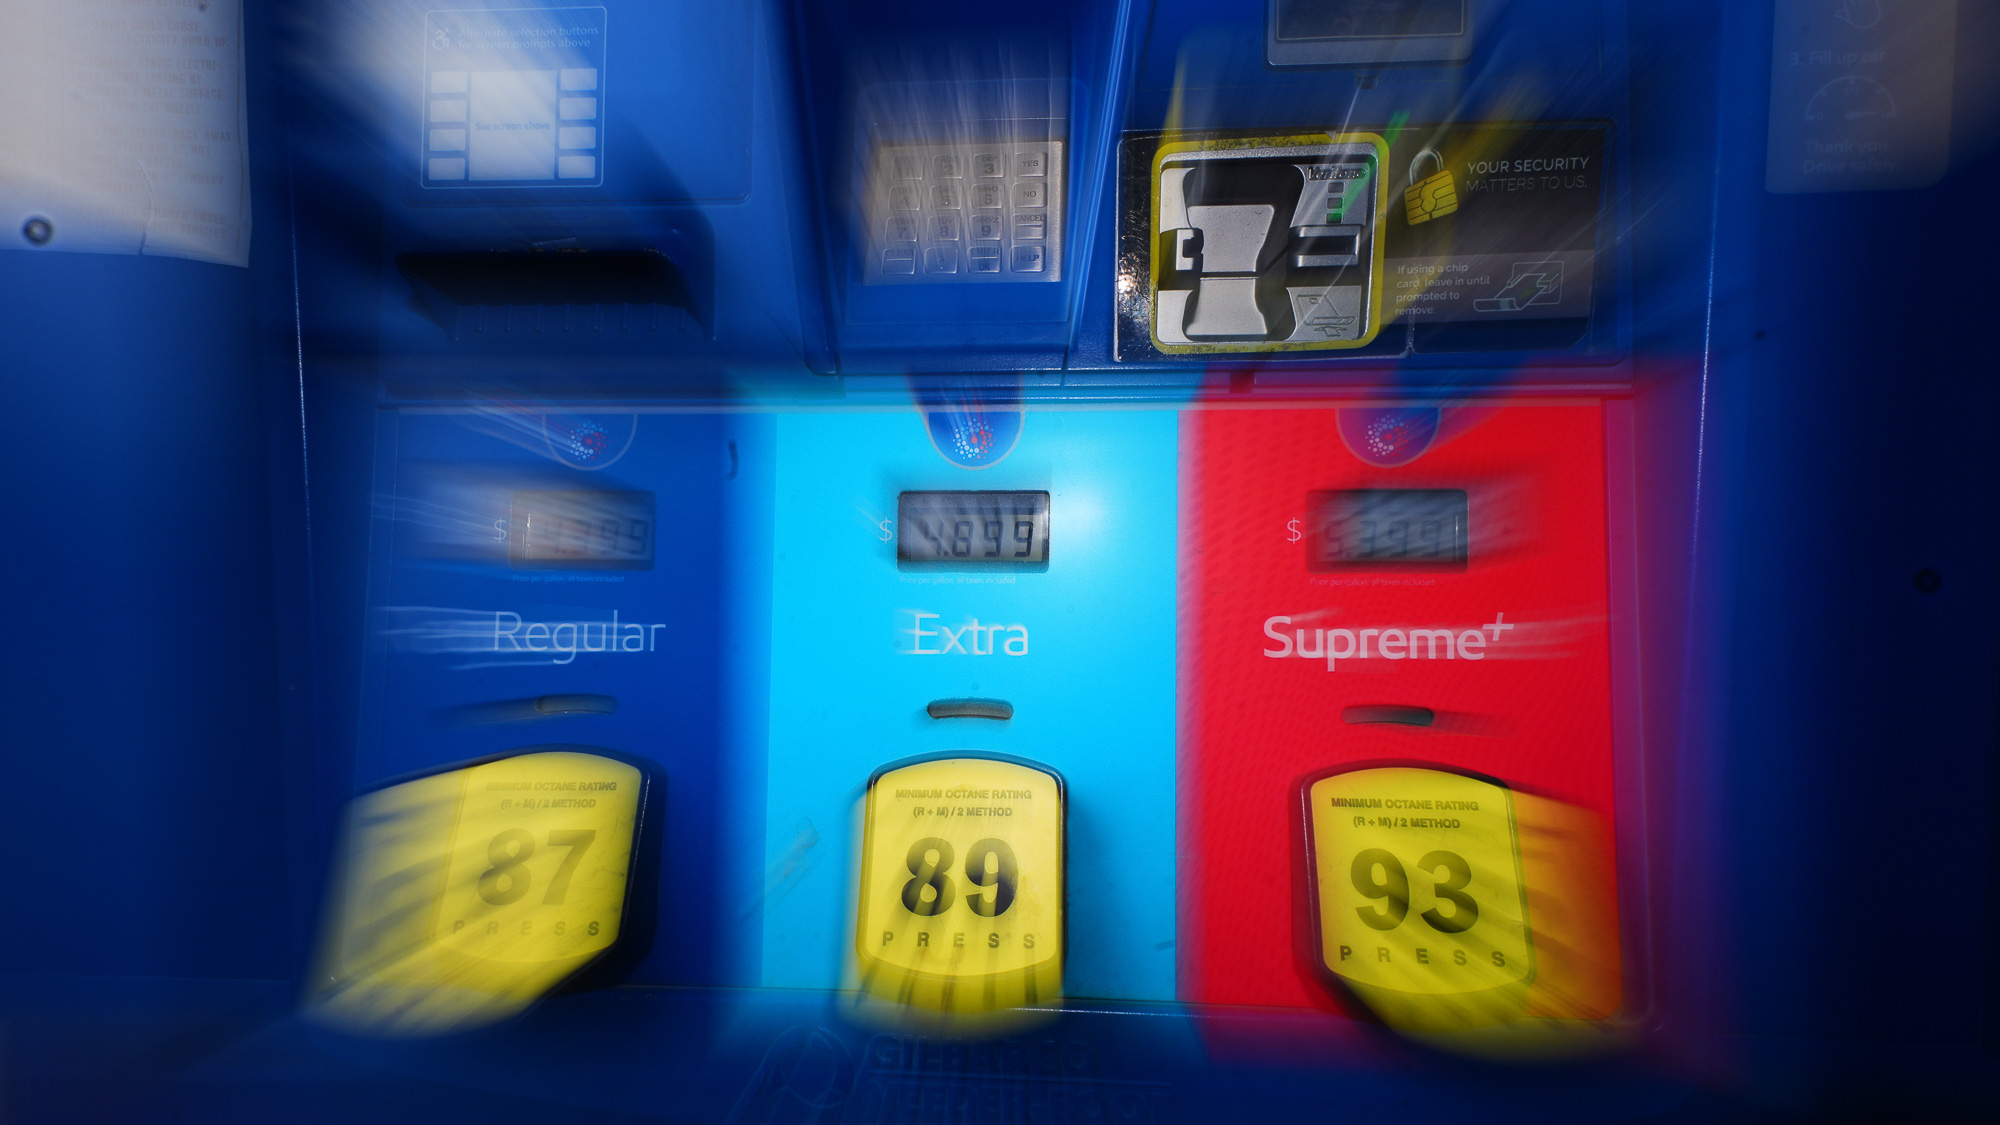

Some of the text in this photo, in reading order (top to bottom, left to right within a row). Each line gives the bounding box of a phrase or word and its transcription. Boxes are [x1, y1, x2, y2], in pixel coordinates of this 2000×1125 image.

[509, 27, 557, 37] selection
[559, 26, 599, 36] buttons
[475, 40, 510, 49] screen
[512, 39, 556, 50] prompts
[558, 38, 590, 48] above
[1789, 51, 1886, 66] 3. Fill up car
[475, 121, 550, 131] See screen above
[1804, 140, 1893, 155] Thank you.
[943, 164, 954, 176] 2
[984, 163, 995, 175] 3
[1022, 160, 1039, 168] YES
[1467, 157, 1589, 175] YOUR SECURITY
[1803, 159, 1901, 175] Drive safely.
[1465, 175, 1588, 193] MATTERS TO US.
[984, 194, 993, 205] 6
[1023, 190, 1037, 198] NO
[941, 195, 952, 207] 5
[939, 226, 949, 238] 8
[981, 225, 992, 238] 9
[1016, 254, 1040, 262] HELP
[1397, 265, 1406, 275] If
[1407, 264, 1434, 277] using
[1446, 263, 1468, 275] chip
[1424, 278, 1452, 287] leave
[1454, 277, 1464, 286] in
[1466, 276, 1490, 286] until
[1396, 291, 1460, 304] prompted to
[1395, 307, 1436, 316] remove.
[878, 517, 893, 544] $
[1286, 517, 1301, 544] $
[595, 574, 625, 583] included
[918, 576, 930, 584] per
[957, 575, 965, 583] all
[966, 575, 985, 584] taxes
[986, 575, 1016, 584] included
[1309, 577, 1328, 585] Price
[1330, 578, 1343, 586] per
[1371, 576, 1380, 585] all
[1380, 577, 1401, 585] taxes
[1402, 576, 1435, 585] included
[493, 609, 666, 665] Regular
[914, 612, 1029, 657] Extra
[1262, 612, 1514, 672] Supreme+
[486, 781, 617, 791] MINIMUM OCTANE RATING
[895, 789, 1032, 800] MINIMUM OCTANE RATING
[500, 798, 512, 810] (R
[524, 798, 536, 810] M)
[543, 799, 551, 809] 2
[551, 798, 597, 809] METHOD
[1331, 797, 1479, 811] MINIMUM OCTANE RATING
[913, 806, 925, 818] (R
[936, 806, 950, 818] M)
[957, 806, 965, 817] 2
[966, 806, 1013, 817] METHOD
[1352, 816, 1366, 829] (R
[1378, 816, 1393, 829] M)
[1400, 818, 1408, 828] 2
[1410, 817, 1460, 829] METHOD
[477, 828, 597, 906] 87
[901, 836, 1019, 917] 89
[1350, 848, 1479, 934] 93
